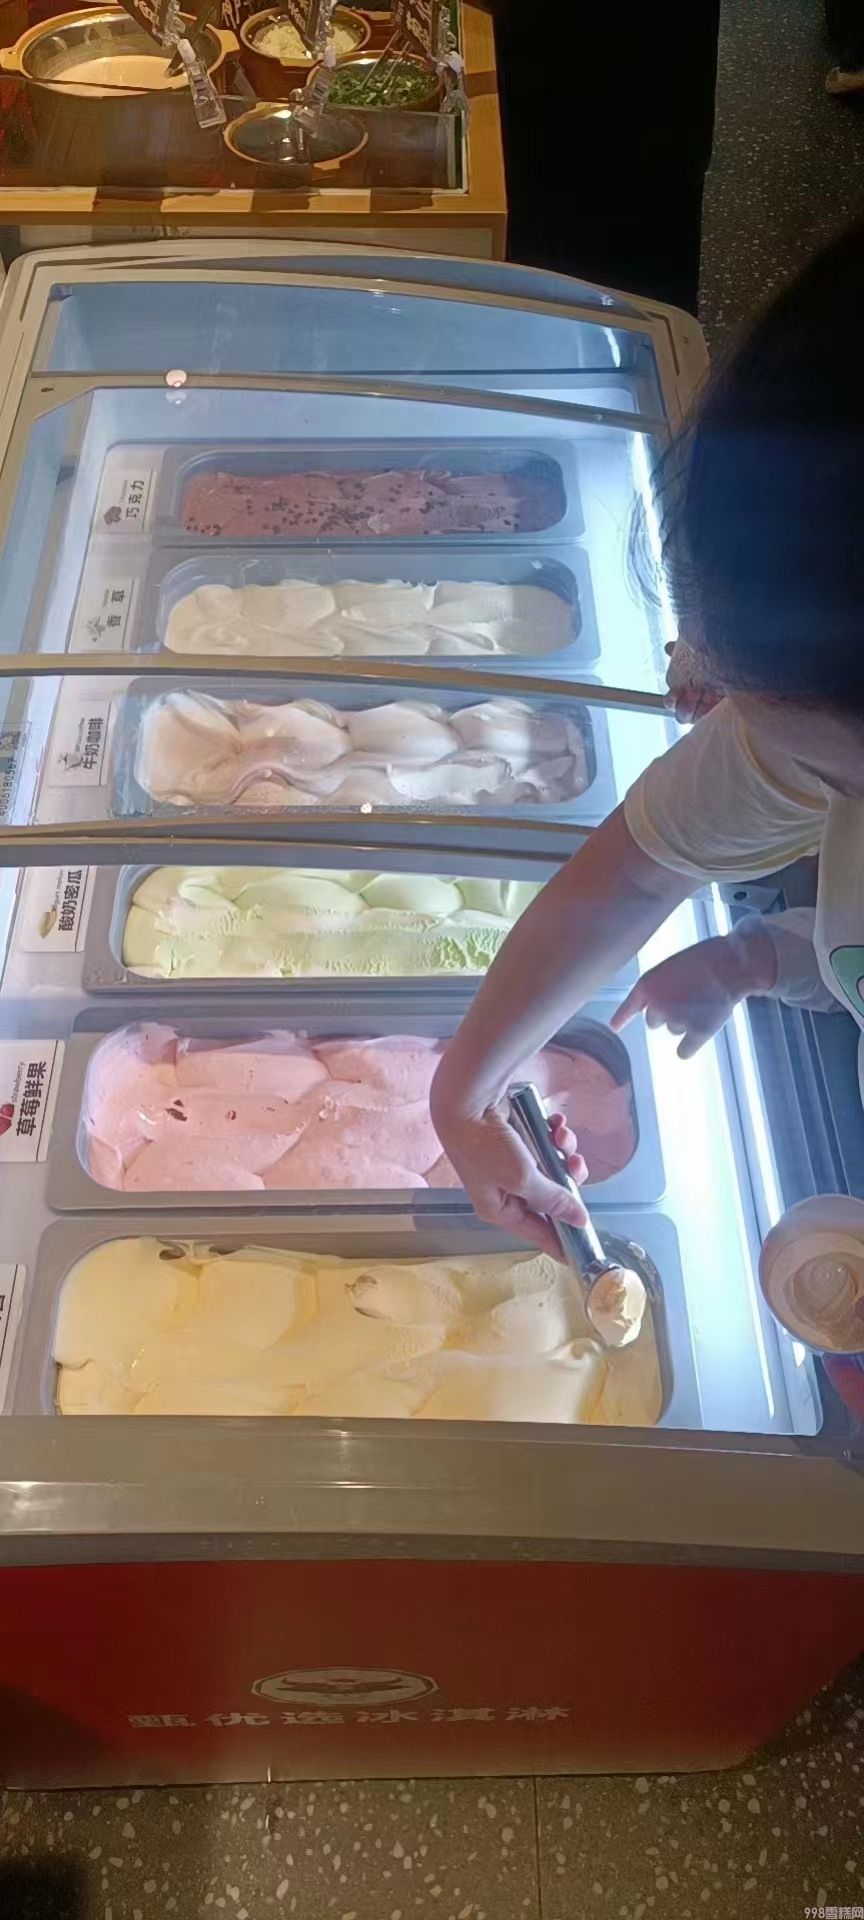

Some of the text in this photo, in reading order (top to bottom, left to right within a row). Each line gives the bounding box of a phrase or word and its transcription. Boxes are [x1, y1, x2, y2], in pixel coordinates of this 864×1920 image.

[125, 480, 144, 519] 巧克力
[106, 589, 126, 628] 香草
[81, 717, 104, 770] 牛奶咖啡
[58, 869, 83, 931] 酸奶密瓜
[11, 1061, 25, 1103] strawberry
[15, 1061, 47, 1137] 草莓鲜果
[127, 1706, 571, 1729] 甄优选冰淇淋
